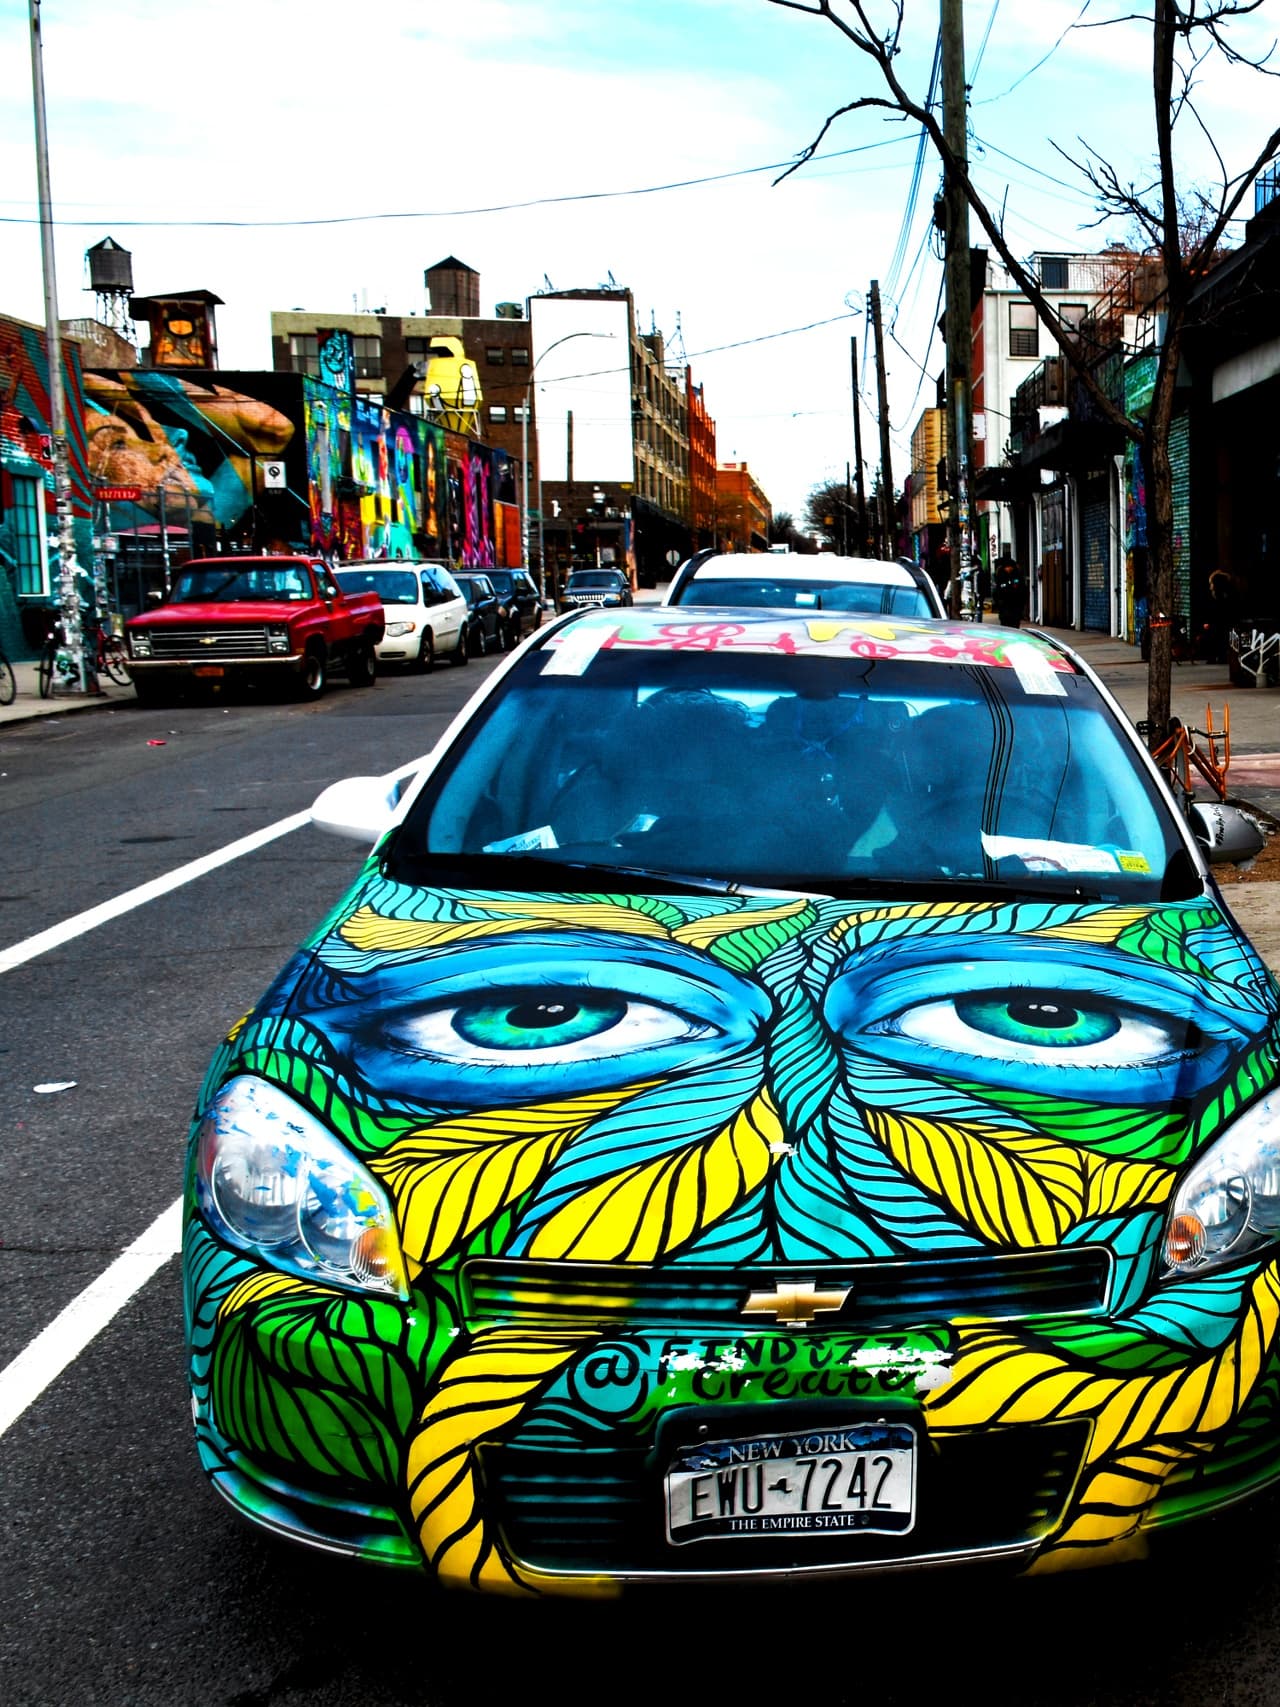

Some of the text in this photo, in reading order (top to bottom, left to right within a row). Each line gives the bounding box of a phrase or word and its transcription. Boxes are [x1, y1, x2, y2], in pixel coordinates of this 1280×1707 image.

[728, 1431, 857, 1465] NEW YORK
[690, 1455, 894, 1522] EWU 7242
[729, 1514, 856, 1531] THE EMPIRE STATE
